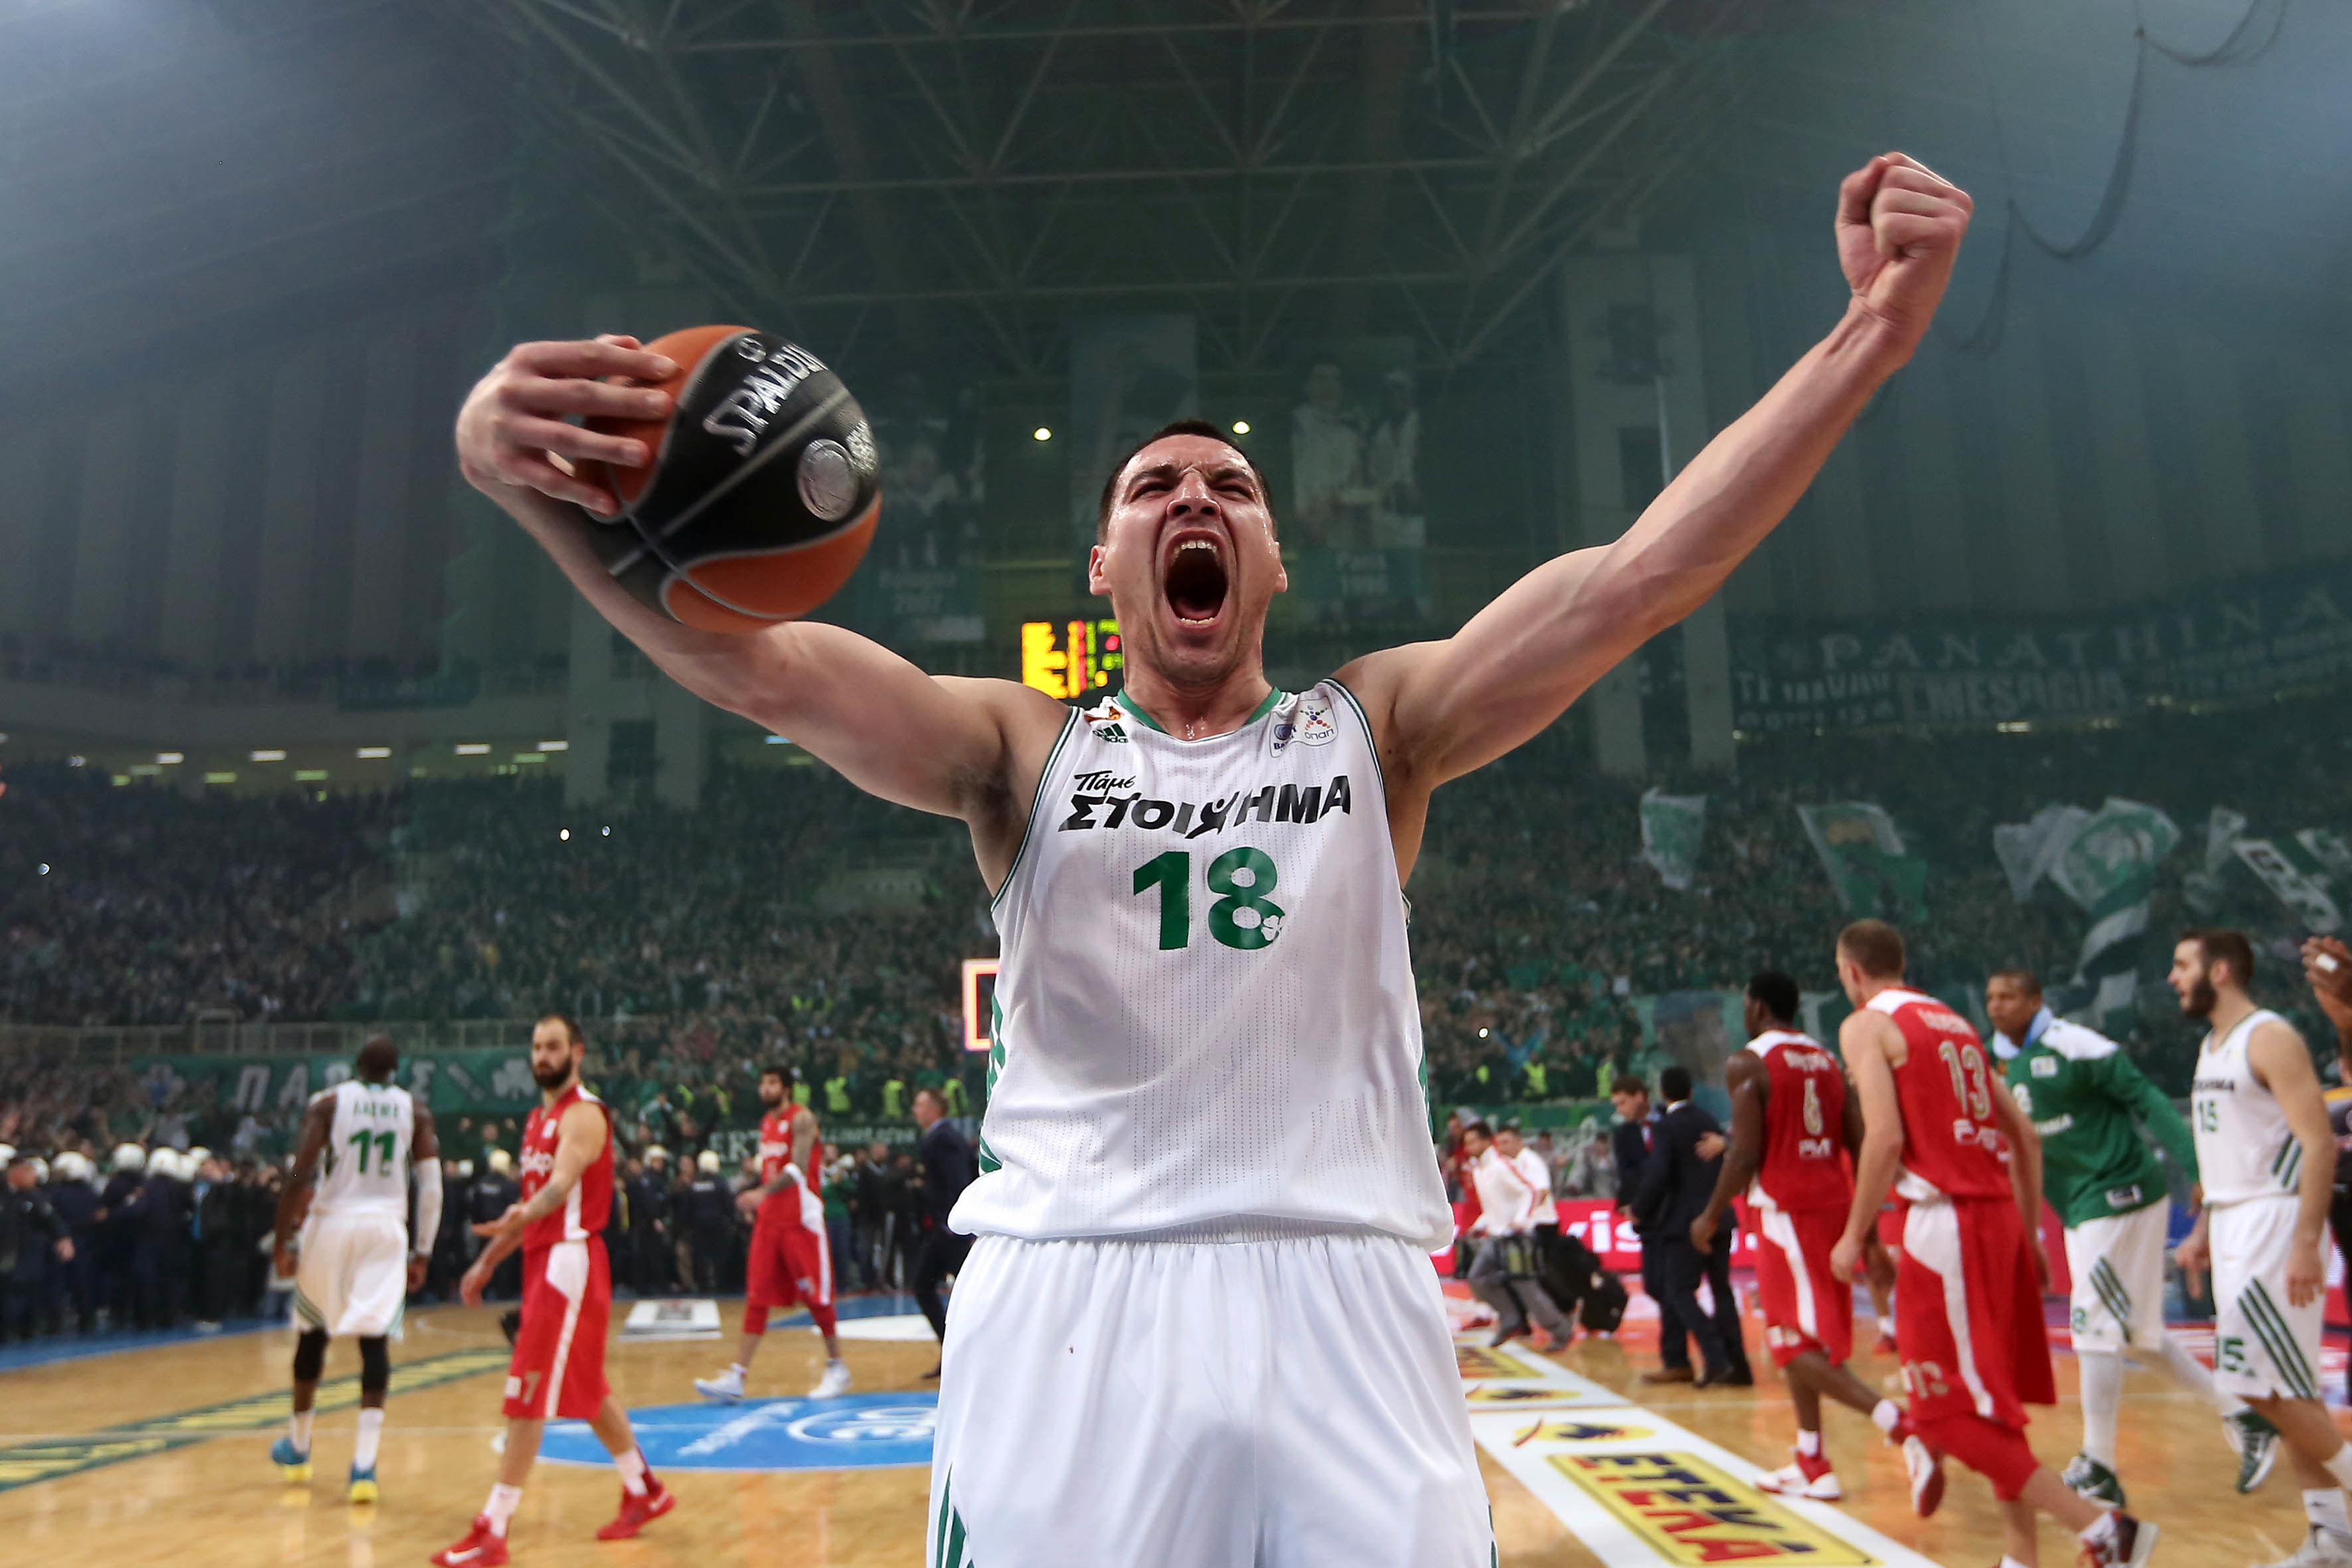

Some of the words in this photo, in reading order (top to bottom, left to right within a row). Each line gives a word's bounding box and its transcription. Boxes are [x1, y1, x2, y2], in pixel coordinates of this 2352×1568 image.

[1073, 770, 1137, 796] Πάμε
[1133, 846, 1286, 951] 18
[1938, 1040, 1990, 1121] 13
[2198, 1100, 2219, 1132] 15
[347, 1126, 399, 1178] 11
